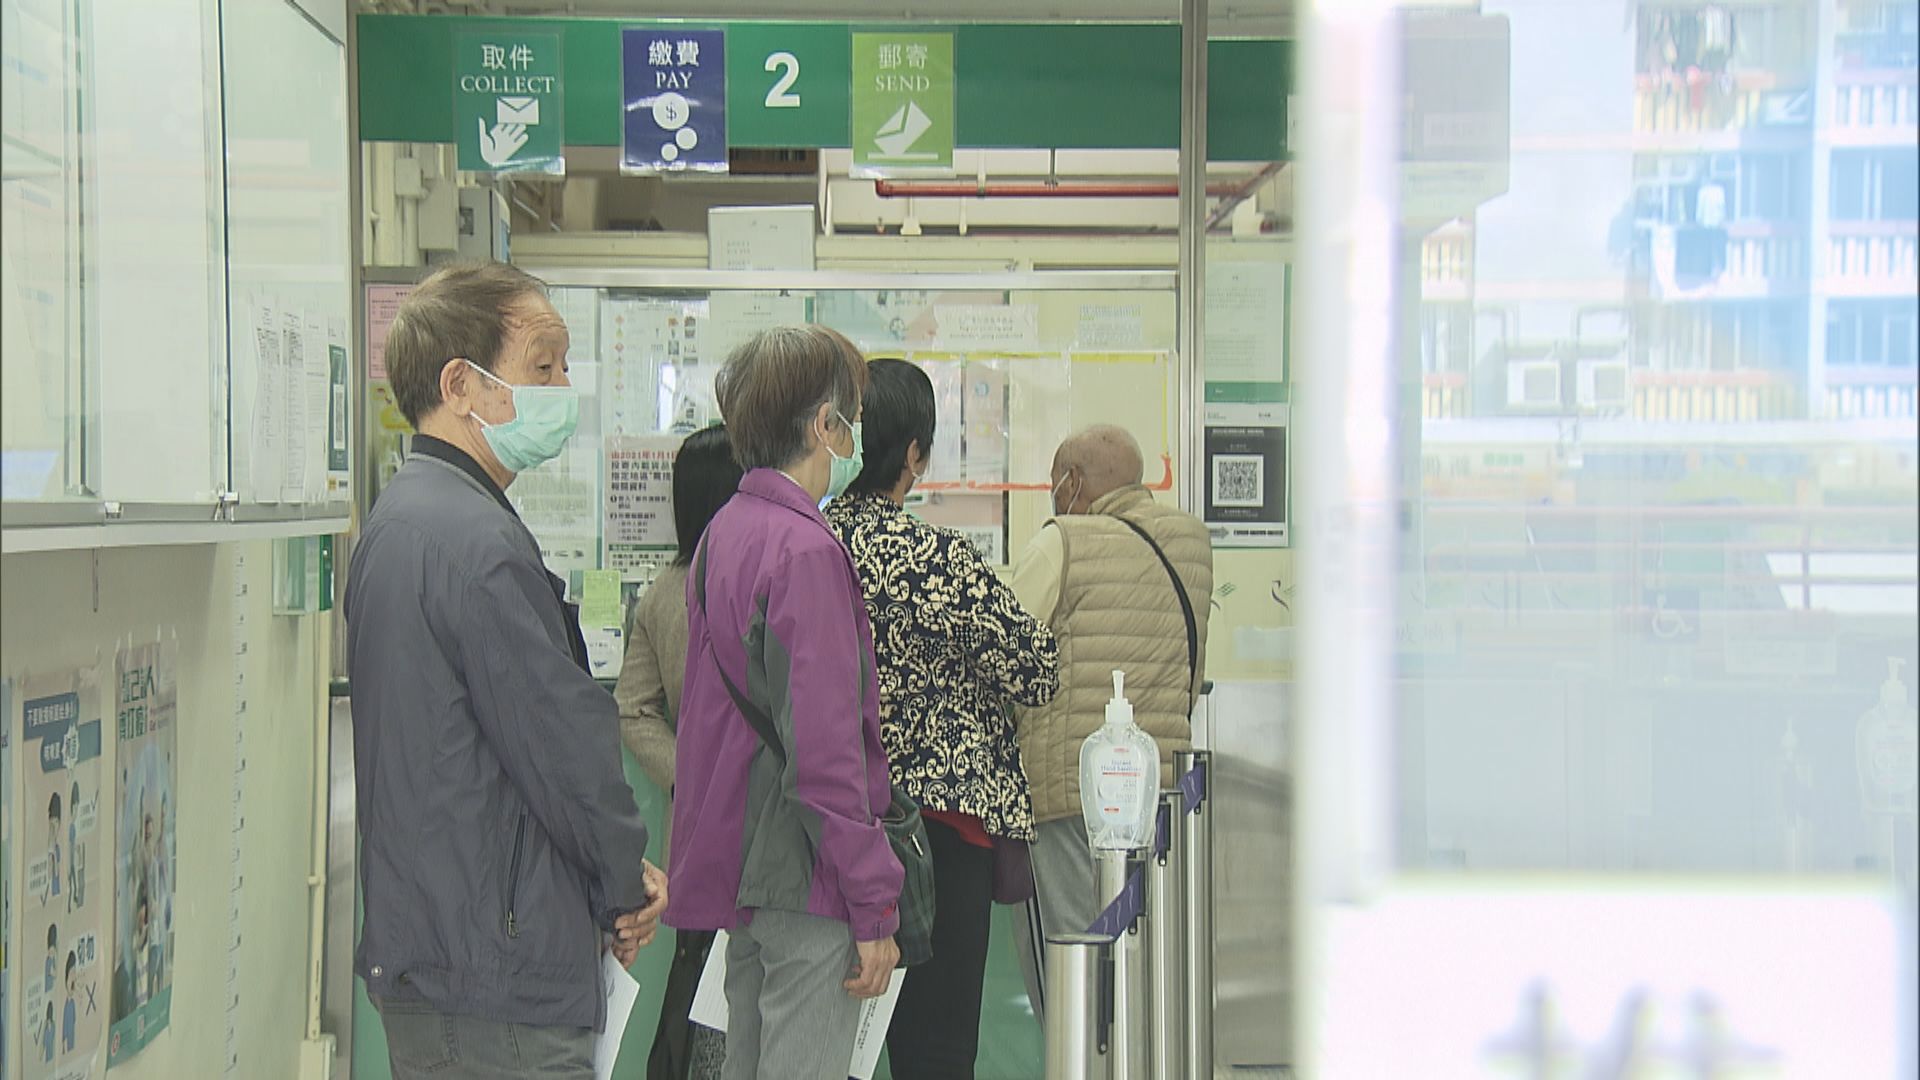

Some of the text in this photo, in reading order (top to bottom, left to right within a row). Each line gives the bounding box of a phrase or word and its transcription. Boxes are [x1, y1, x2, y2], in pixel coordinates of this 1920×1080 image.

[481, 43, 534, 71] 取件
[648, 40, 700, 67] 繳費
[878, 43, 928, 70] 郵寄
[460, 75, 555, 94] COLLECT
[655, 71, 693, 90] PAY
[764, 51, 801, 108] 2
[875, 74, 931, 93] SEND
